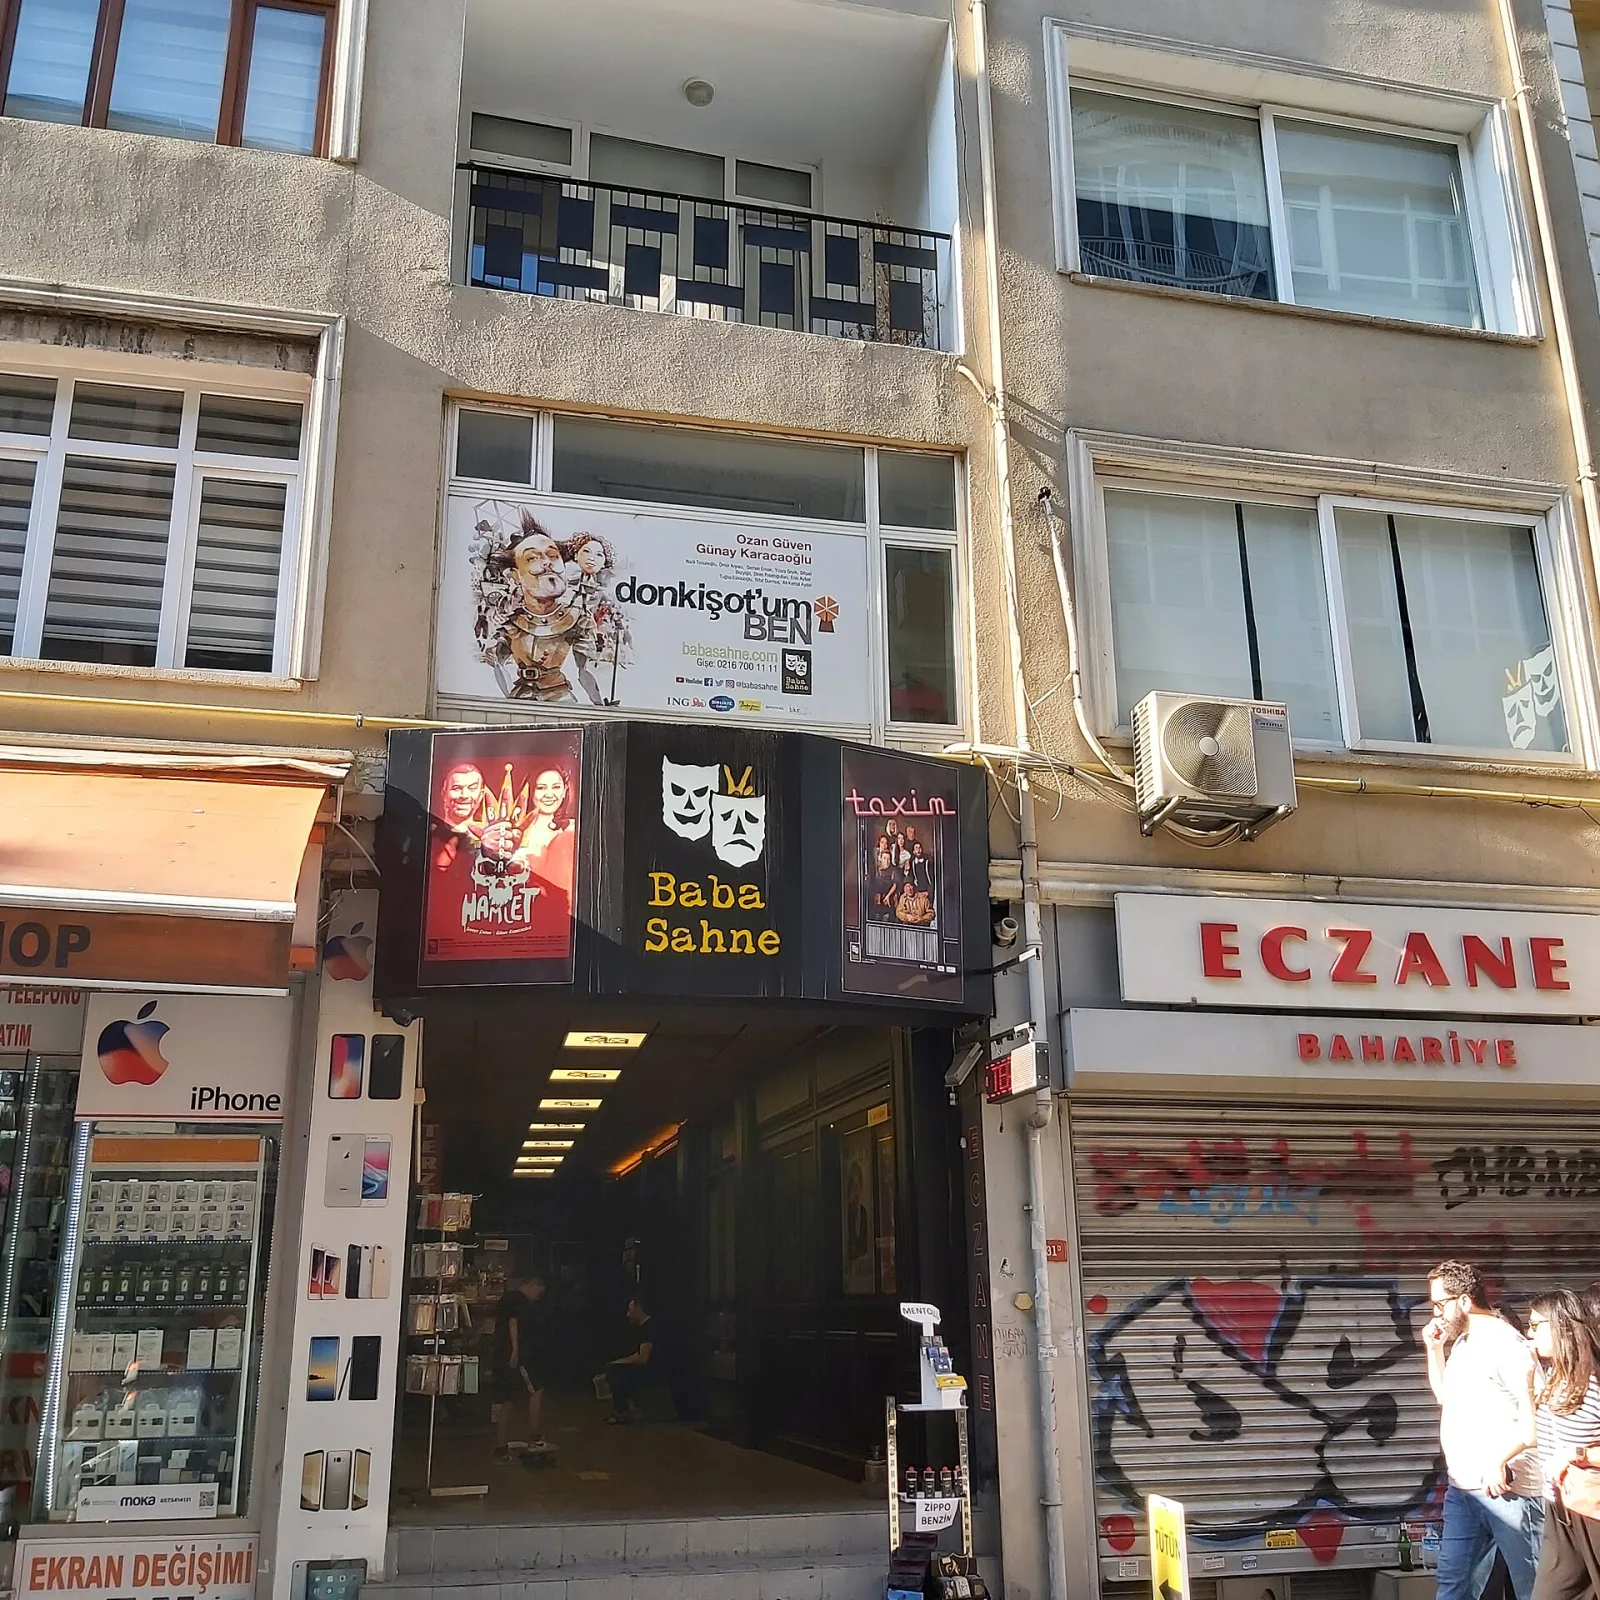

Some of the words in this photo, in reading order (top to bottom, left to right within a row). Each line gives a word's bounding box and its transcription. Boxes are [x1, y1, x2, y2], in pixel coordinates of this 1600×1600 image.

[696, 543, 737, 559] Günay
[740, 548, 811, 566] Karacaoğlu
[736, 534, 768, 547] Ozan
[772, 538, 811, 551] Güven
[744, 613, 812, 645] BEN
[682, 642, 778, 662] babasahne.com
[696, 657, 715, 669] Gişe:
[717, 659, 737, 670] 0216
[739, 661, 754, 671] 700
[756, 663, 765, 672] 11
[769, 664, 777, 673] 11
[667, 696, 690, 707] ING
[1251, 707, 1286, 716] TOSHIBA
[845, 788, 956, 815] taxim
[648, 873, 766, 910] Baba
[462, 888, 541, 926] HAMLET
[0, 921, 91, 968] OP
[645, 918, 781, 955] Sahne
[1199, 922, 1571, 991] ECZANE
[1296, 1030, 1517, 1064] BAHARİYE
[190, 1086, 281, 1111] iPhone
[968, 1126, 991, 1412] ECZANE
[921, 1513, 952, 1525] BENZİN
[924, 1501, 951, 1512] ZİPPO
[29, 1555, 124, 1591] EKRAN
[132, 1542, 253, 1594] DEĞİŞİMİ
